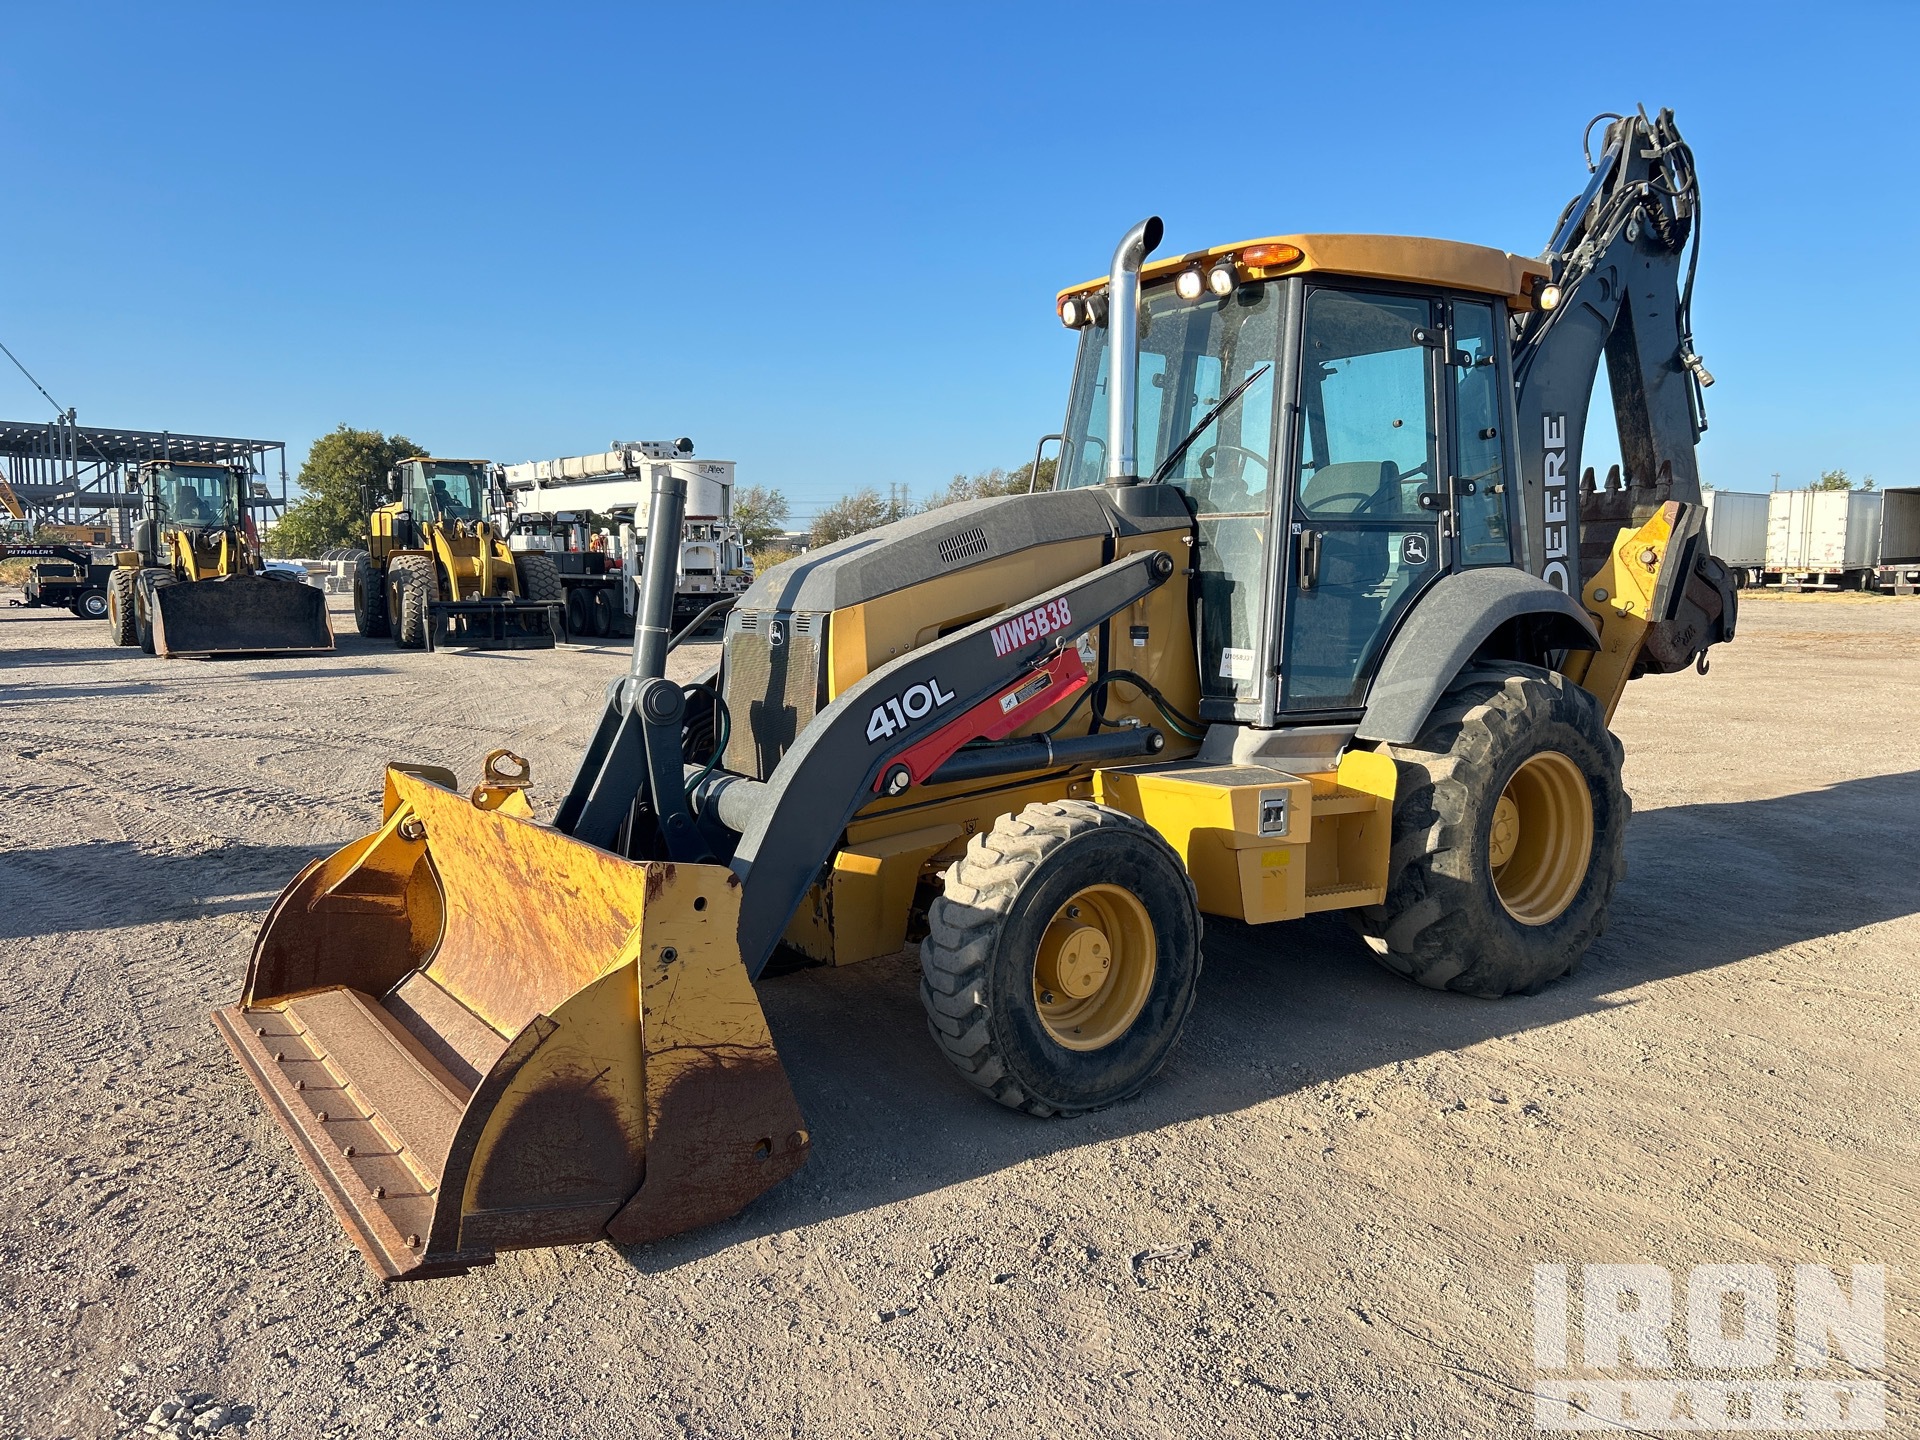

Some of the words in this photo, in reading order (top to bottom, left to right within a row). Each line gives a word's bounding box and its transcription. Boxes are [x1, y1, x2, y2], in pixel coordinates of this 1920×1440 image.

[1543, 415, 1569, 596] DEERE
[990, 596, 1072, 658] MW5B38
[866, 678, 956, 742] 410L
